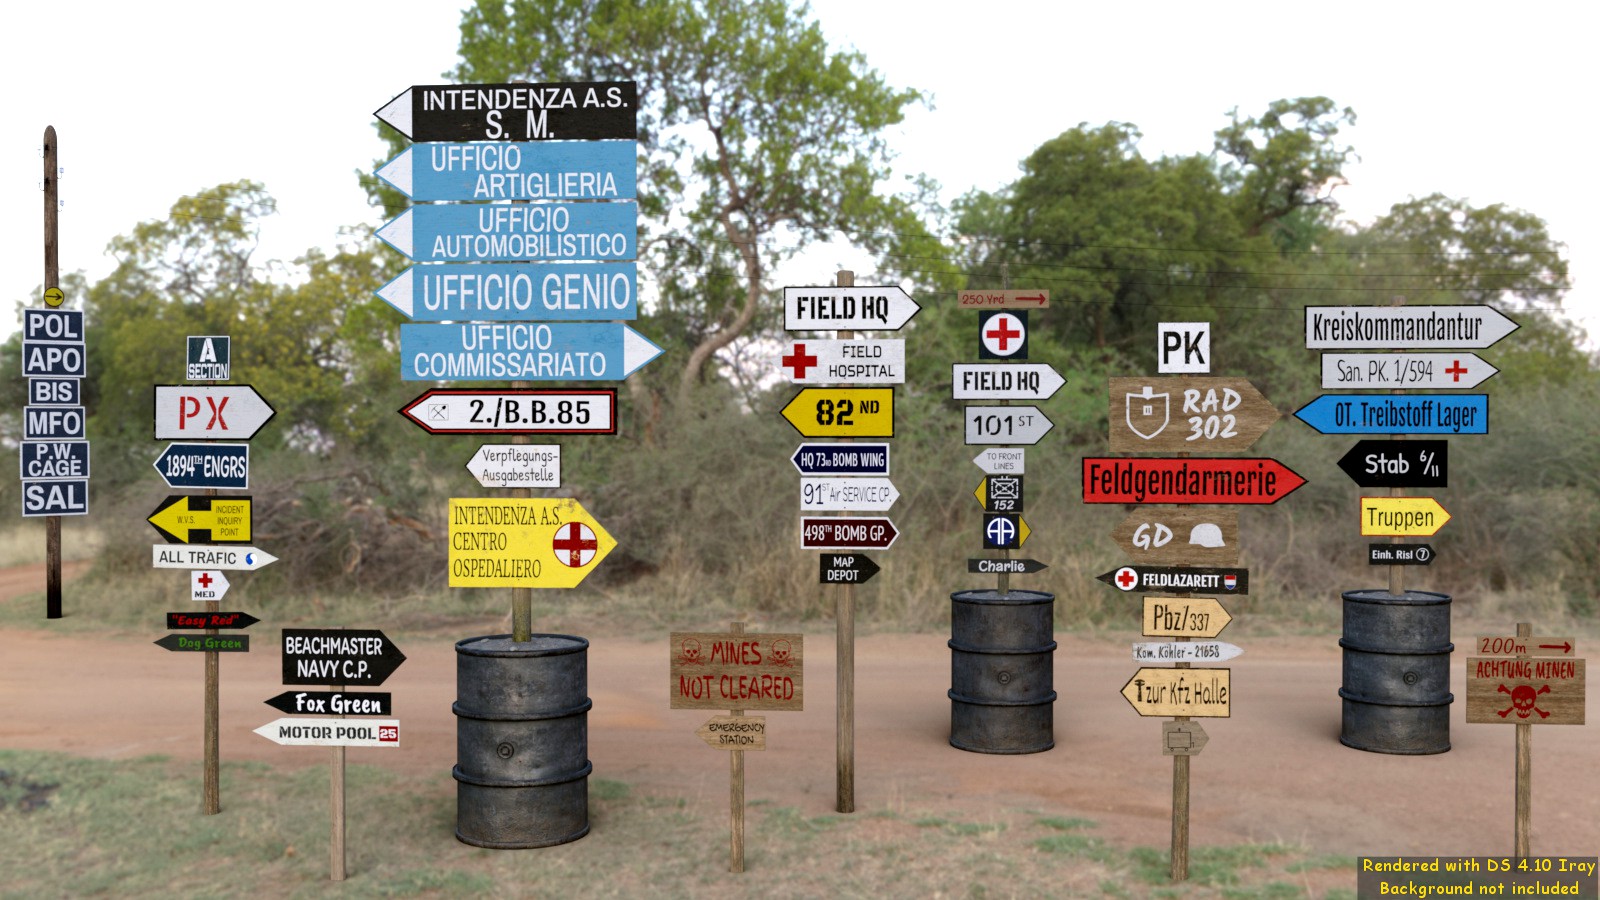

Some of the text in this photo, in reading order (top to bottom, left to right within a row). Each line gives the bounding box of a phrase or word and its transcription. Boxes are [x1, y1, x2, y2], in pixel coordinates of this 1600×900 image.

[423, 87, 628, 111] INTENDENZA A.S.
[432, 145, 521, 172] UFFICIO
[474, 172, 618, 198] ARTIGLIERIA
[479, 206, 570, 233] UFFICIO
[432, 233, 627, 258] AUTOMOBILISTICO
[423, 273, 630, 311] UFFICIO GENIO
[962, 294, 1005, 305] 250 Yrd
[797, 296, 888, 324] FIELD HQ
[30, 313, 78, 338] POL
[1313, 311, 1482, 341] Kreiskommandantur
[462, 324, 552, 350] UFFICIO
[199, 338, 217, 362] A
[842, 345, 882, 358] FIELD
[1163, 331, 1205, 364] PK
[27, 347, 81, 373] APO
[414, 352, 607, 377] COMMISSARIATO
[188, 363, 228, 379] SECTION
[829, 365, 895, 377] HOSPITAL
[1337, 358, 1433, 386] San. PK. 1/594
[36, 382, 73, 402] BIS
[963, 371, 1040, 395] FIELD HQ
[1183, 387, 1242, 413] RAD
[29, 411, 80, 435] MFO
[179, 396, 230, 430] PX
[1361, 400, 1433, 427] Treibstoff
[1437, 402, 1478, 432] Lager
[1185, 414, 1238, 441] 302
[482, 448, 558, 467] Verpflegungs-
[801, 452, 814, 469] HQ
[832, 452, 858, 467] BOMB
[860, 452, 884, 467] WING
[987, 452, 1022, 460] TO FRONT
[1365, 452, 1409, 474] Stab
[28, 460, 82, 477] CAGE
[203, 455, 246, 478] ENGRS
[482, 468, 554, 486] Ausgabestelle
[1090, 463, 1276, 502] Feldgendarmerie
[26, 485, 84, 511] SAL
[829, 487, 841, 502] Air
[842, 486, 877, 502] SERVICE
[216, 506, 244, 514] INCIDENT
[994, 500, 1015, 510] 152
[177, 516, 196, 524] W.V.S.
[217, 517, 242, 526] INQUIRY
[454, 506, 563, 525] INTENDENZA A.S.
[1367, 508, 1434, 530] Truppen
[220, 528, 239, 536] POINT
[453, 532, 507, 551] CENTRO
[834, 525, 867, 541] BOMB
[870, 525, 888, 541] GP.
[1132, 523, 1173, 550] GD
[159, 550, 237, 565] ALL TRAFIC
[833, 556, 854, 567] MAP
[1372, 549, 1394, 559] Einh.
[453, 559, 541, 578] OSPEDALIERO
[827, 569, 859, 581] DEPOT
[978, 560, 1025, 572] Charlie
[1143, 573, 1220, 588] FELDLAZARETT
[194, 590, 215, 598] MED
[178, 636, 242, 651] Dog Green
[286, 636, 383, 656] BEACHMASTER
[711, 641, 762, 666] MINES
[1137, 646, 1156, 659] Kom.
[1158, 644, 1185, 658] Köhler
[1195, 645, 1220, 658] 21658
[1482, 638, 1526, 654] 200m
[297, 659, 372, 679] NAVY C.P.
[1477, 661, 1575, 680] ACHTUNG MINEN
[680, 674, 794, 700] NOT CLEARED
[1146, 677, 1227, 705] zur Kfz Halle
[295, 692, 382, 714] Fox Green
[279, 726, 397, 740] MOTOR POOL 25
[709, 723, 765, 734] EMERGENCY
[720, 734, 754, 745] STATION
